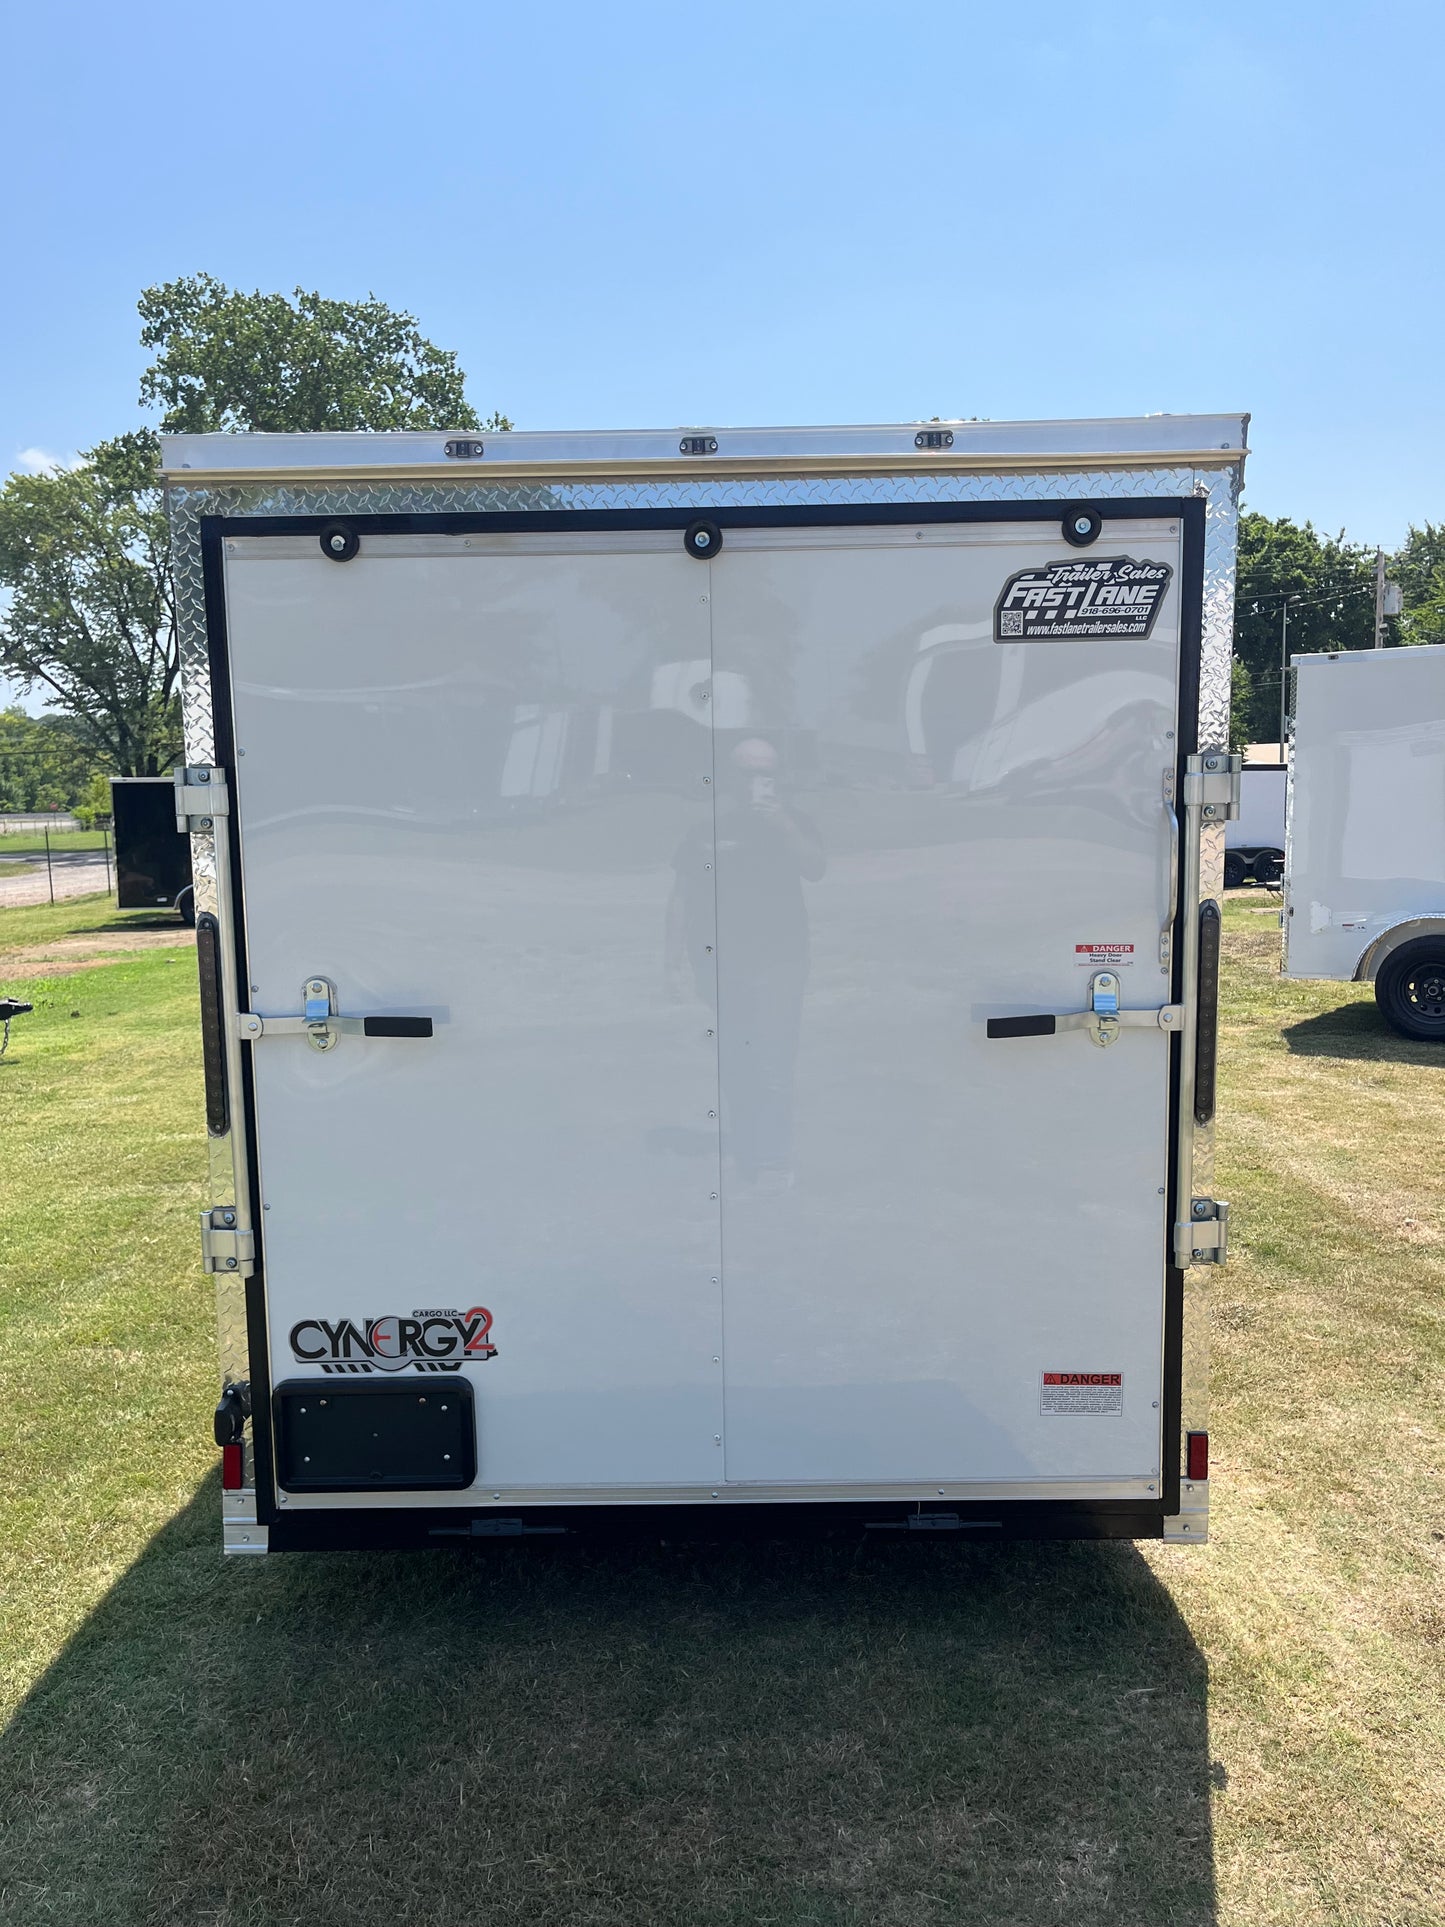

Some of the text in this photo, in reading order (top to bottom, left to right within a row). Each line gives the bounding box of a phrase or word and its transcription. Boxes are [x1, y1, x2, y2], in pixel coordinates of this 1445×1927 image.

[1051, 565, 1166, 583] Trailer Sales
[1081, 607, 1149, 615] 918-696-0701
[1027, 621, 1146, 634] www.fastlanetrailersales.com
[1060, 1374, 1120, 1384] DANGER
